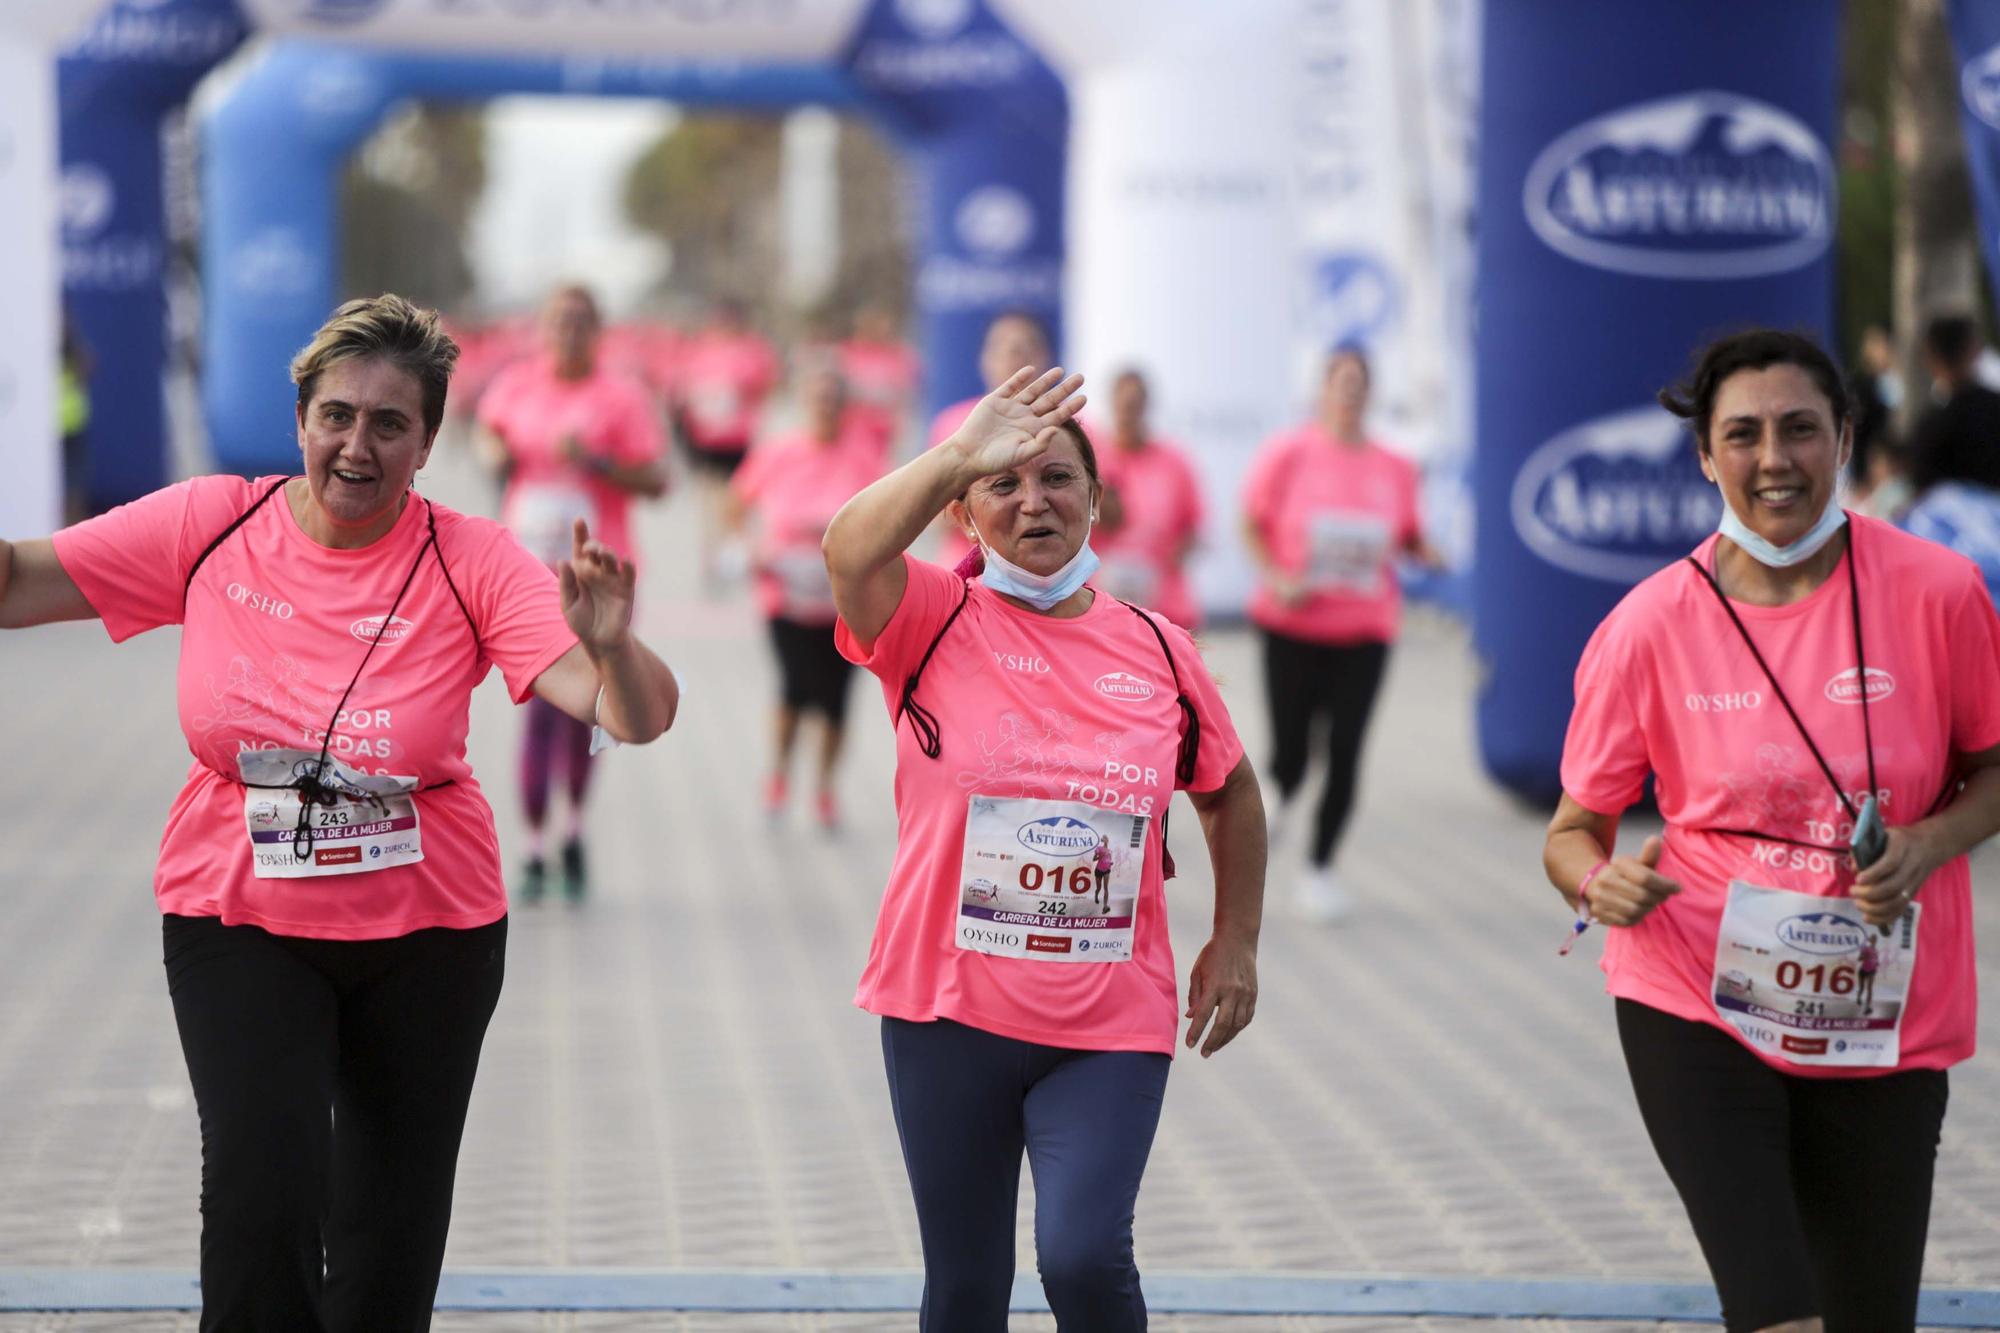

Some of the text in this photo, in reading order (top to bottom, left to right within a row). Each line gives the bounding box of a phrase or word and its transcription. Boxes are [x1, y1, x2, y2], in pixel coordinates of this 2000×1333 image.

[226, 583, 293, 619] OYSHO
[994, 652, 1050, 673] YSHO
[1100, 681, 1150, 696] ASTURIANA
[1685, 691, 1761, 712] OYSHO
[334, 709, 391, 729] POR
[303, 729, 391, 758] TODAS
[1104, 761, 1158, 786] POR
[1066, 781, 1154, 815] TODAS
[320, 812, 349, 826] 243
[327, 828, 342, 839] DE
[344, 828, 358, 838] LA
[359, 822, 393, 835] MUJER
[1024, 828, 1094, 847] ASTURIANA
[384, 842, 411, 854] ZURICH
[1019, 863, 1092, 894] 016
[1038, 901, 1067, 915] 242
[993, 911, 1108, 928] CARRERA DE LA MUJER
[963, 927, 1019, 947] OYSHO
[1038, 940, 1066, 949] Santander
[1093, 940, 1122, 950] ZURICH
[1784, 924, 1861, 946] ASTURIANA
[1776, 960, 1856, 994] 016
[1794, 1001, 1825, 1016] 241
